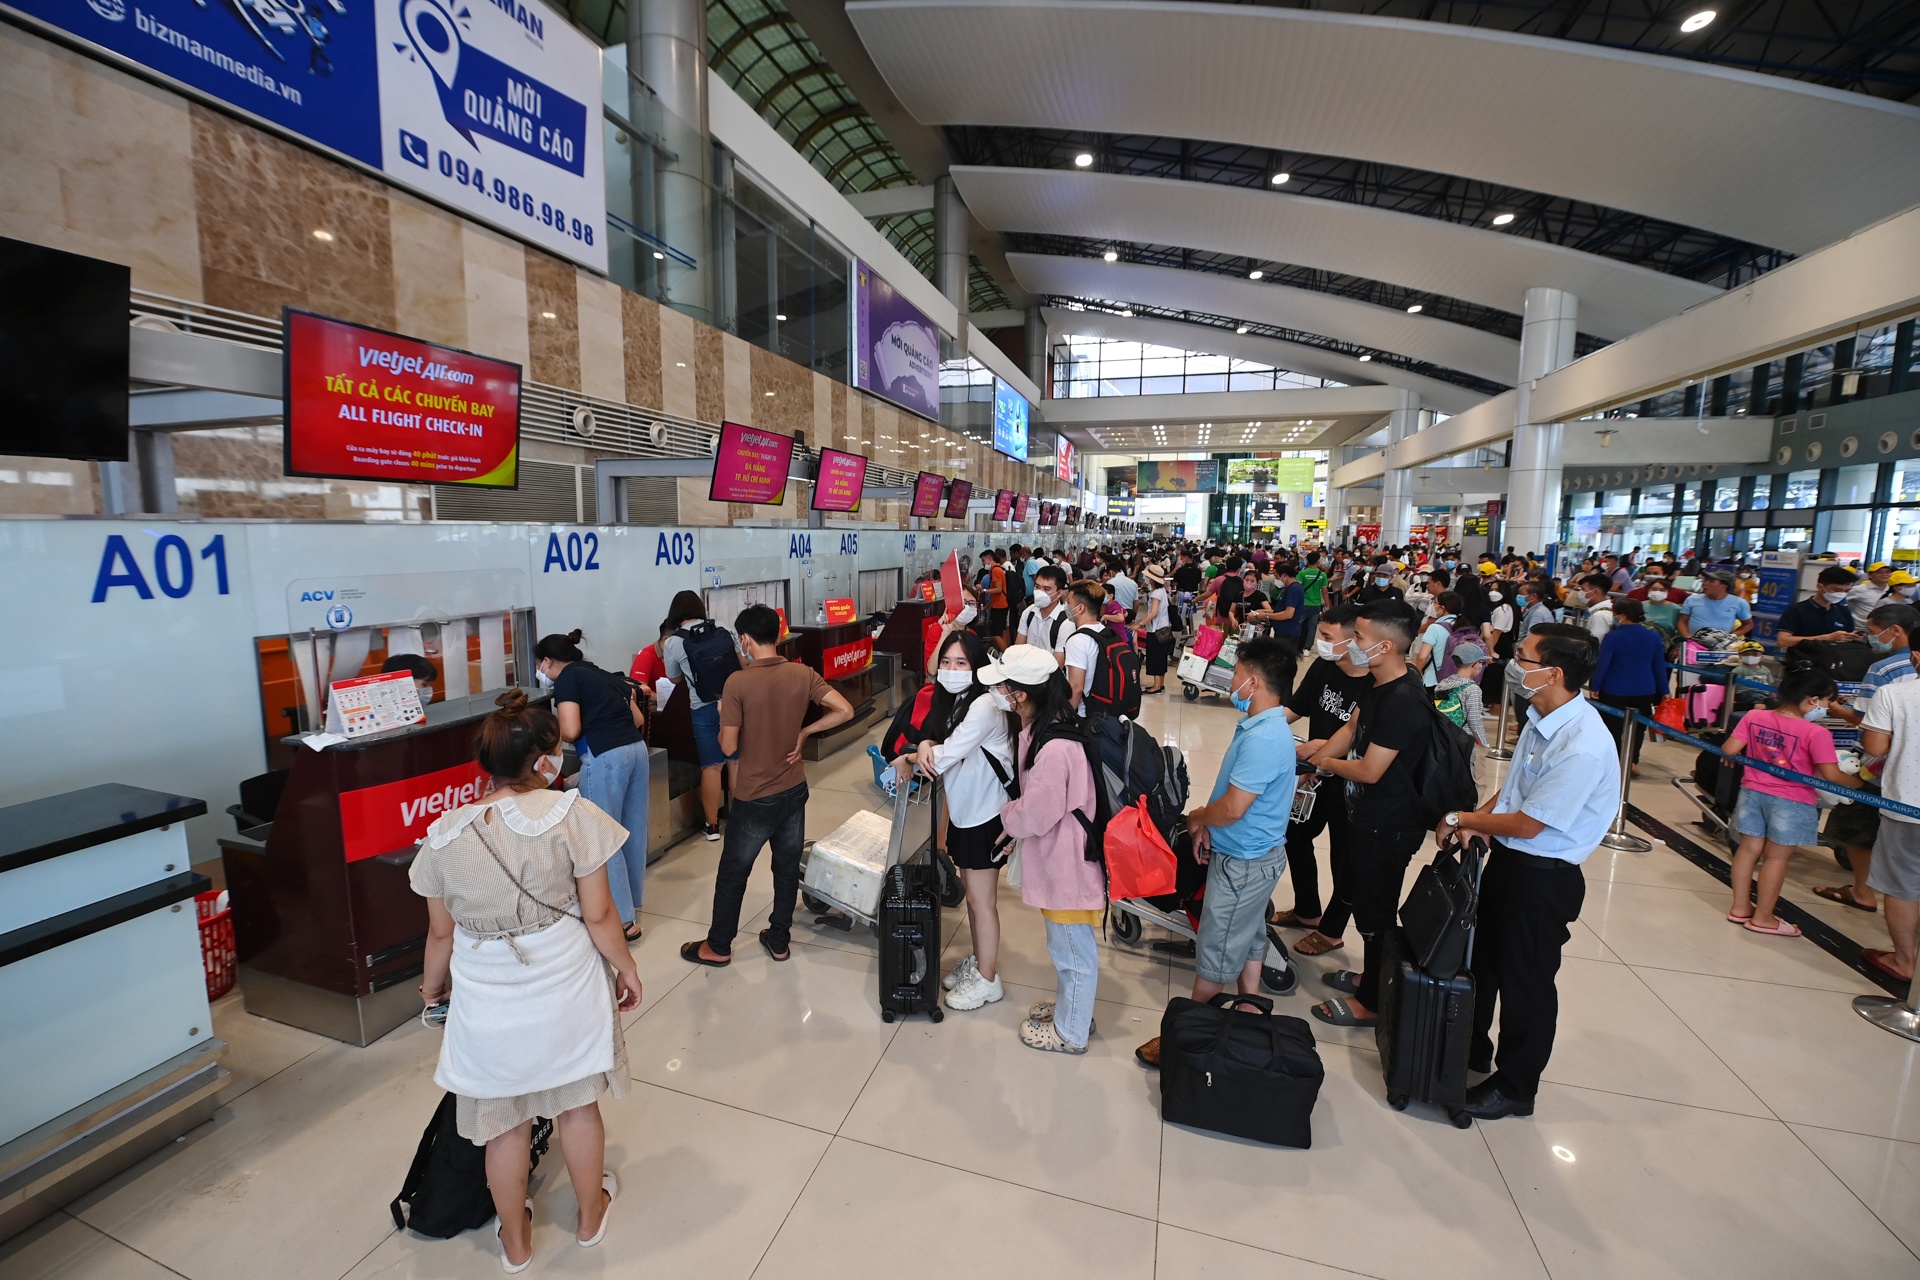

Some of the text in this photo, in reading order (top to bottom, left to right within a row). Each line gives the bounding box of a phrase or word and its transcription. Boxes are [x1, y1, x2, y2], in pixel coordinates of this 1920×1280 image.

[135, 7, 302, 106] bizmanmedia.vn
[506, 77, 541, 118] MỜI
[464, 89, 574, 163] QUẢNG CÁO
[438, 150, 594, 246] 094.986.98.98
[325, 373, 494, 418] TẤT CẢ CÁC CHUYẾN BAY
[338, 404, 482, 437] ALL FLIGHT CHECK-IN
[544, 532, 600, 573] A02
[654, 532, 695, 567] A03
[789, 533, 812, 559] A04
[840, 533, 858, 556] A05
[904, 534, 916, 552] A06
[931, 534, 941, 550] A07
[91, 534, 231, 603] A01
[300, 590, 334, 602] ACV
[1762, 582, 1778, 597] 40
[1757, 622, 1773, 636] 15
[1755, 736, 1786, 750] TIGHT
[1758, 729, 1784, 743] HOLD
[1828, 785, 1891, 808] INTERNATIONAL
